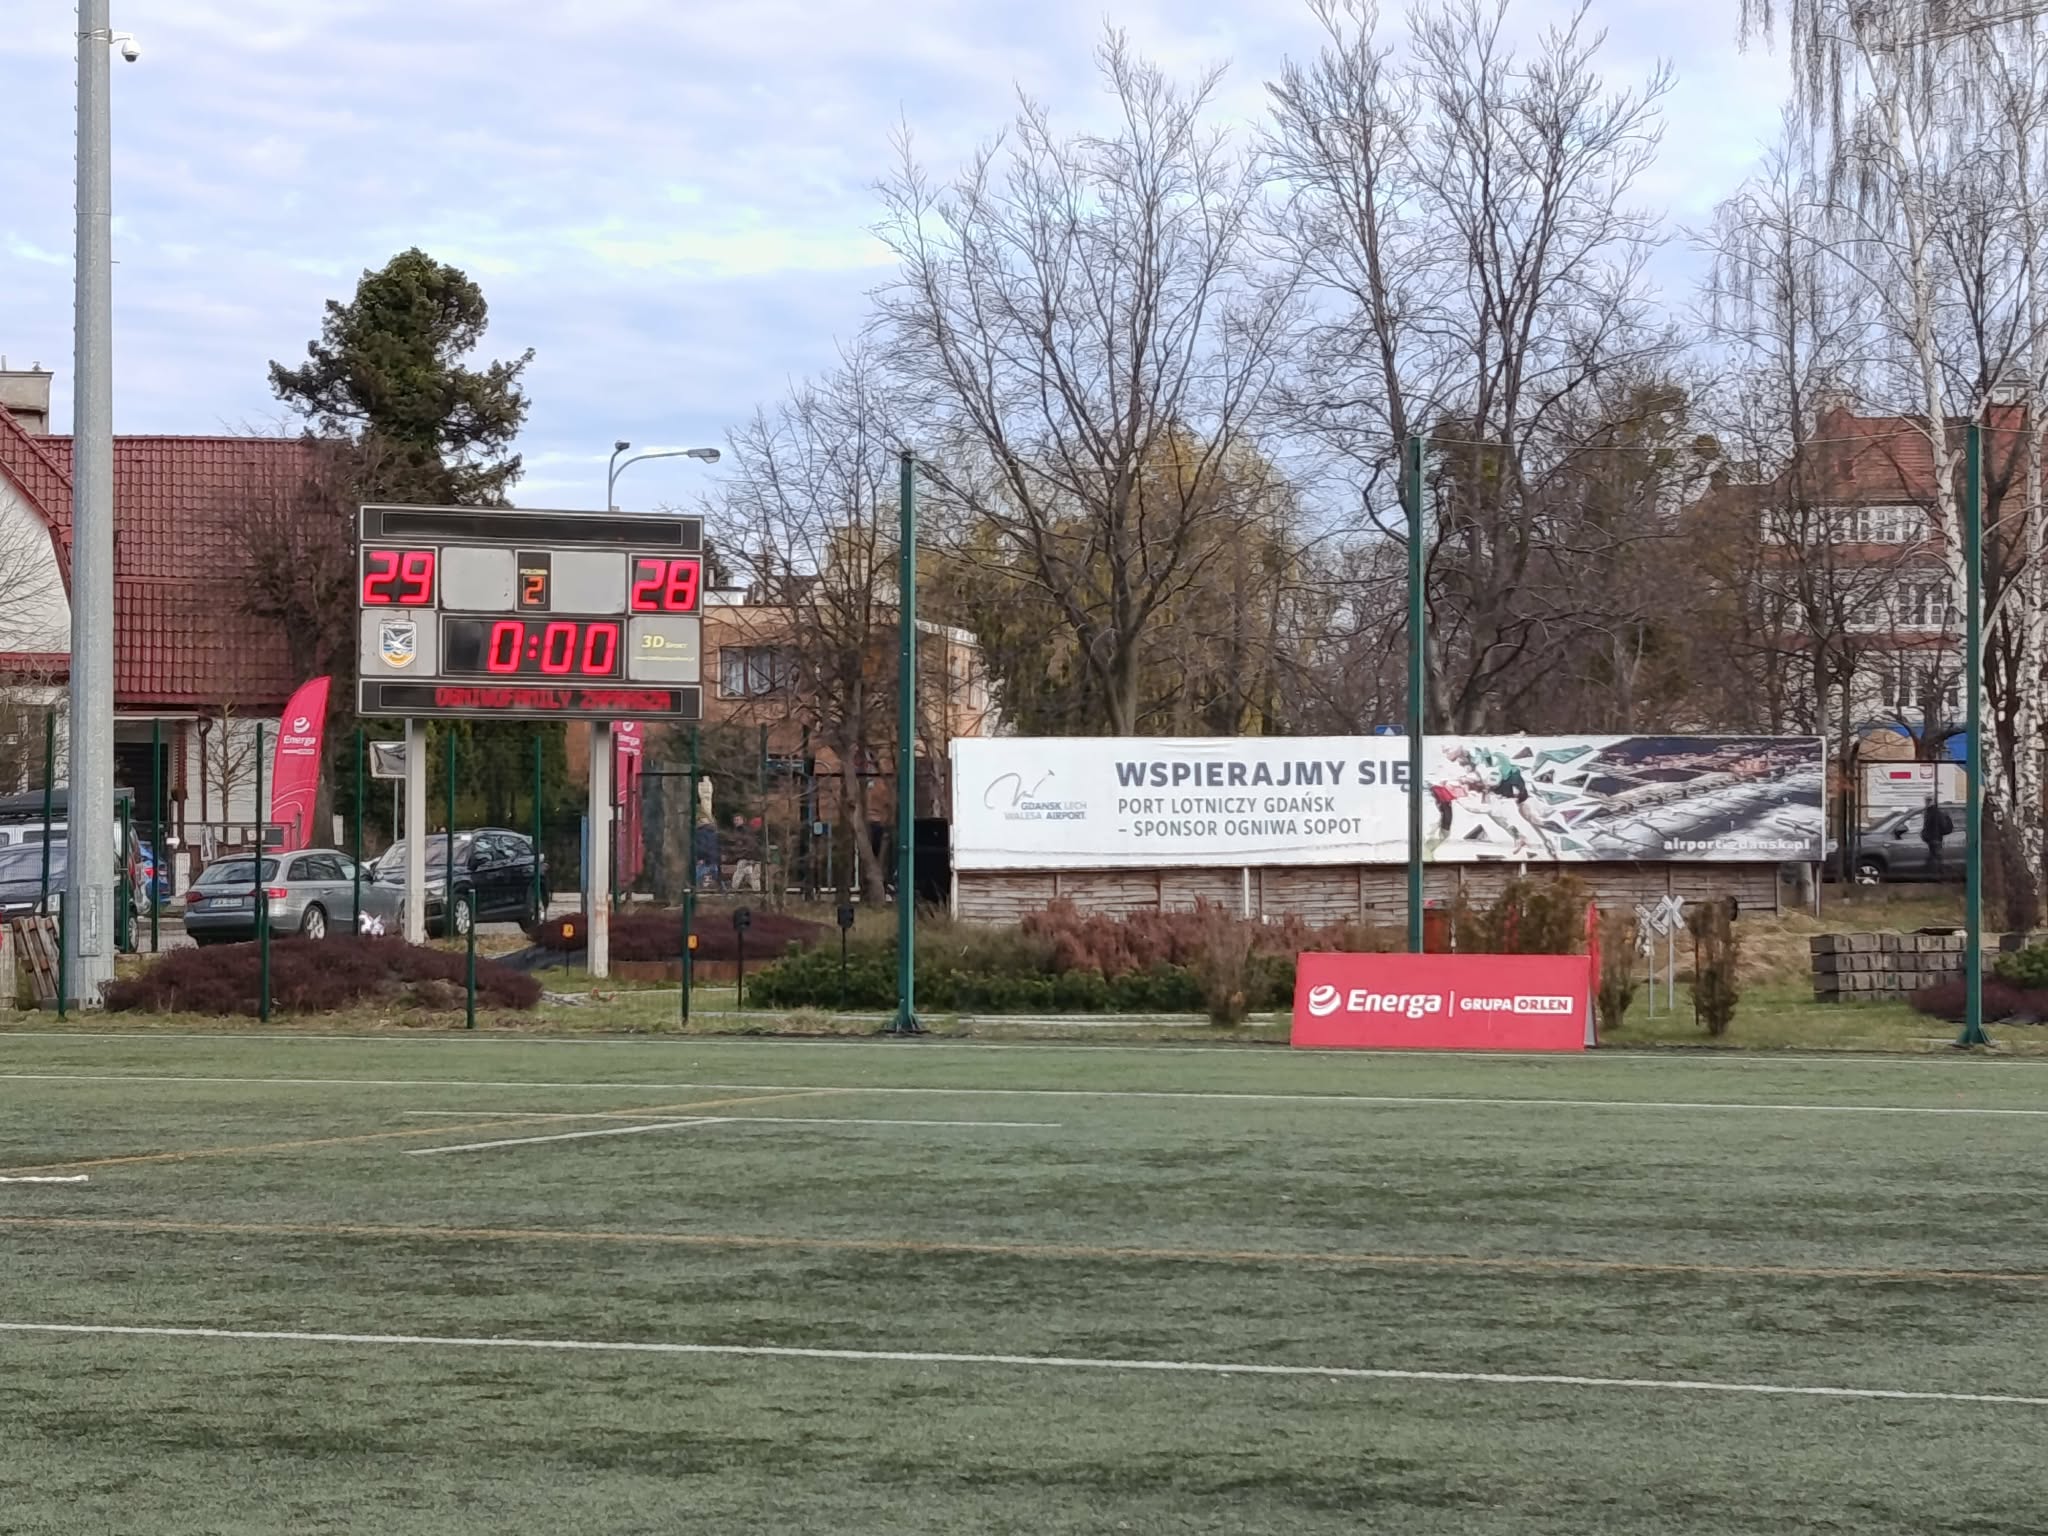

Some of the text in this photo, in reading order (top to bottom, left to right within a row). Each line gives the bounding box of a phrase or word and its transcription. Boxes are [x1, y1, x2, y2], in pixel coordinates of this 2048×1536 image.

[363, 551, 435, 604] 29
[524, 576, 543, 604] 2
[631, 559, 700, 611] 28
[488, 621, 618, 674] 0:00
[641, 634, 665, 649] 3D
[1115, 759, 1411, 793] WSPIERAJMY SIĘ
[1046, 811, 1086, 820] AIRPORT
[1118, 791, 1336, 815] PORT LOTNICZY GDAŃSK
[1134, 818, 1218, 837] SPONSOR
[1224, 818, 1298, 836] OGNIWA
[1304, 817, 1361, 835] SOPOT
[1346, 989, 1568, 1019] Energa GRUPA ORLEN
